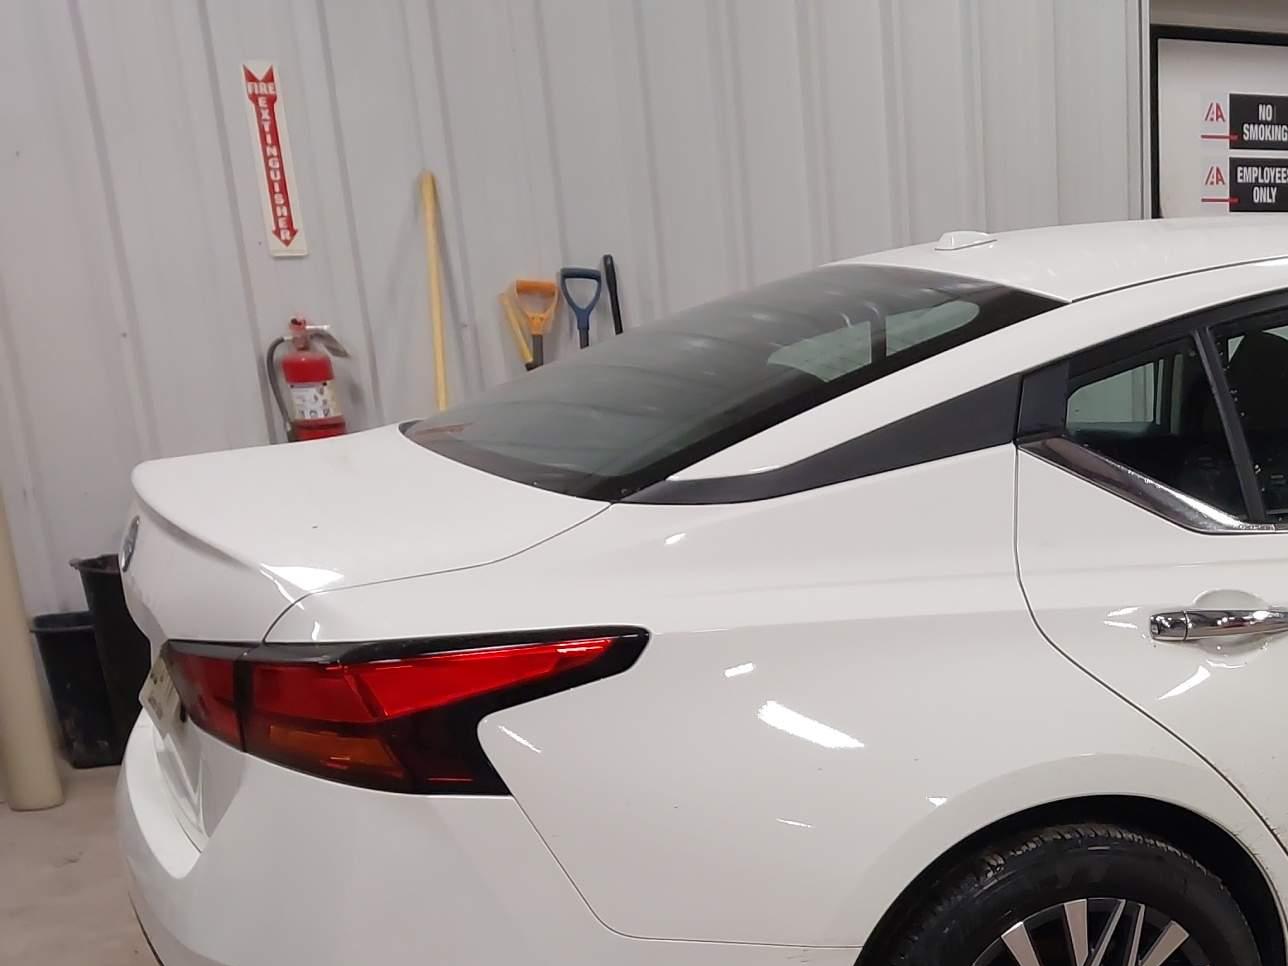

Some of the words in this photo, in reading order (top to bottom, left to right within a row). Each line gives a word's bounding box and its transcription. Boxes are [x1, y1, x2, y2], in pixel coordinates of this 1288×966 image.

[247, 82, 275, 95] FIRE
[1258, 104, 1273, 121] NO
[1242, 123, 1288, 142] SMOKING
[257, 96, 291, 241] EXTINGUISHER
[1252, 186, 1277, 203] ONLY
